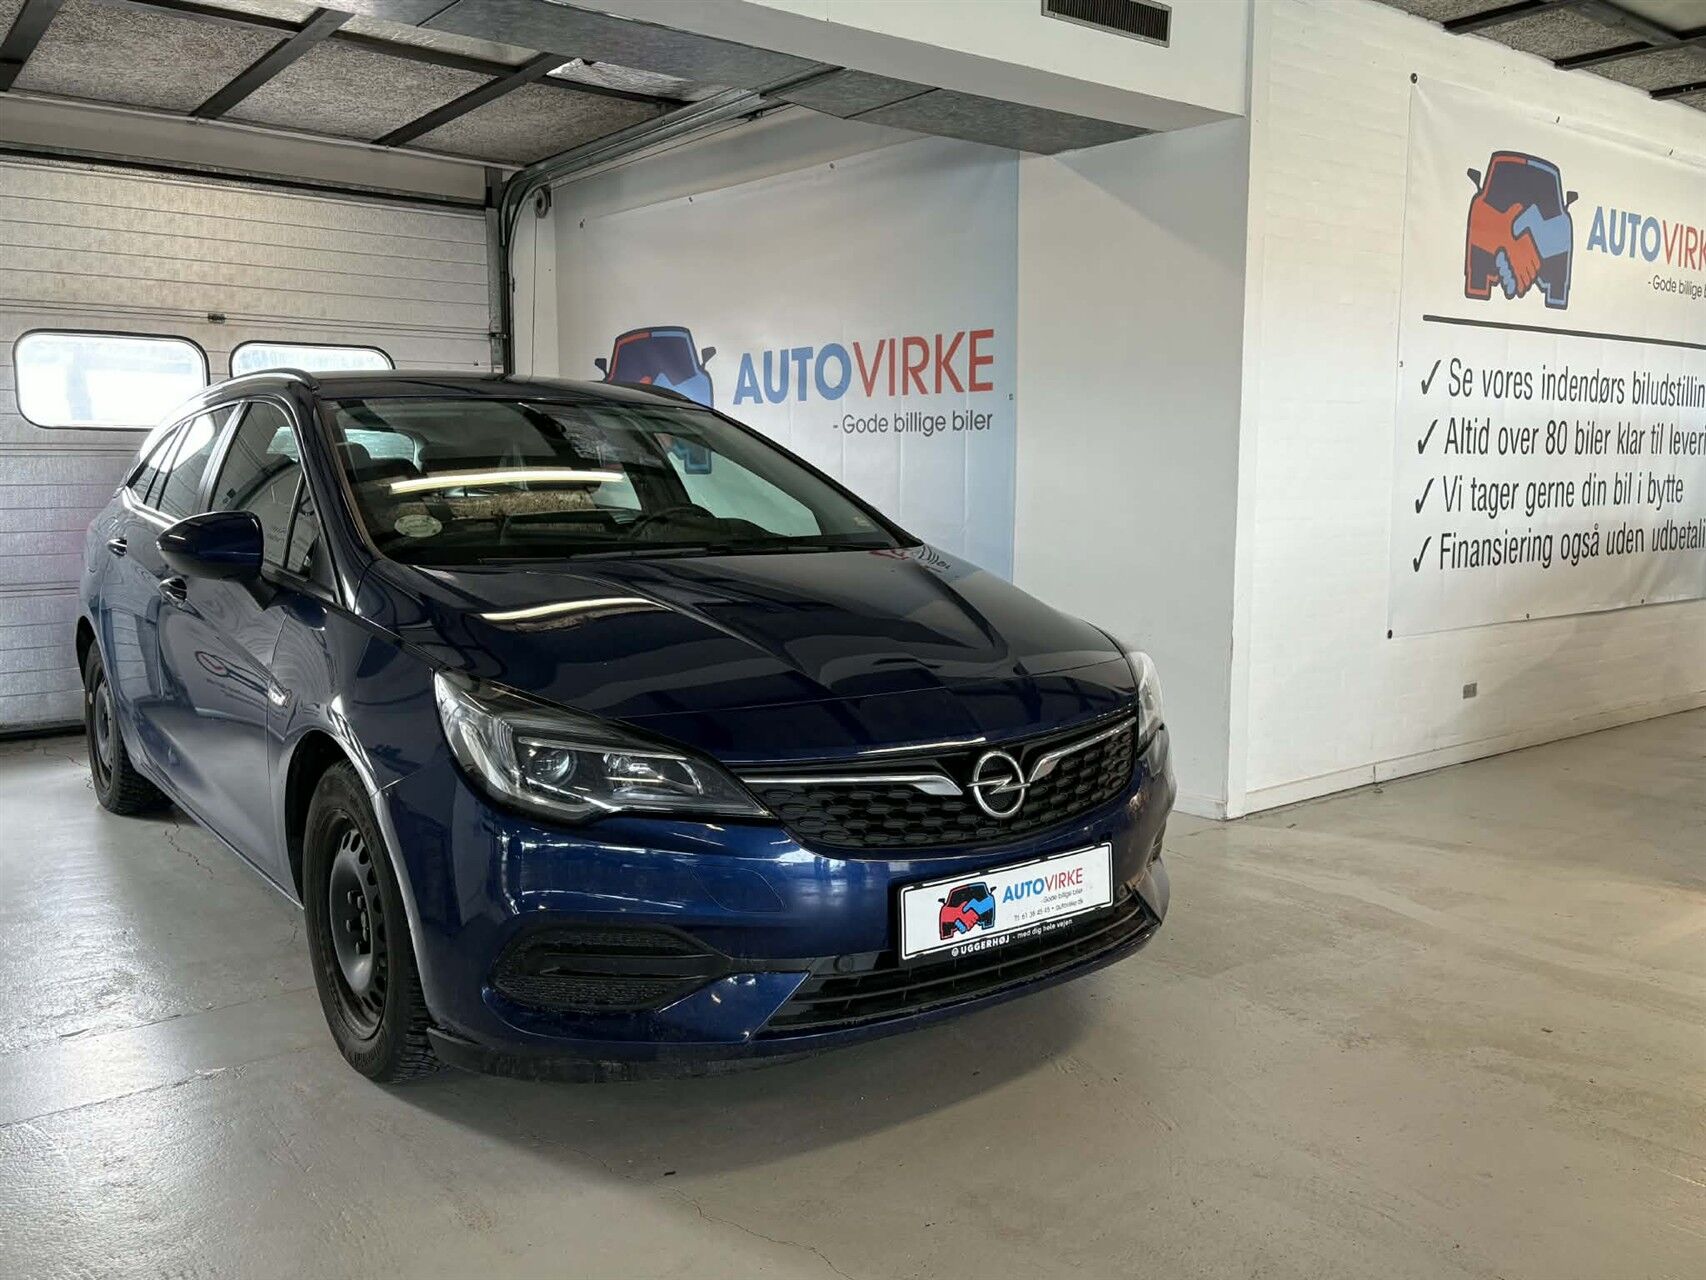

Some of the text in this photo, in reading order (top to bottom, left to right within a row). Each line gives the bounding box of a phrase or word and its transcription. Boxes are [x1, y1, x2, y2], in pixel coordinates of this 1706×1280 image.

[1653, 275, 1677, 293] Gode
[1679, 280, 1702, 300] billige
[733, 328, 994, 405] AUTOVIRKE
[1448, 357, 1706, 409] Se vores indendørs biludstillin
[843, 413, 889, 434] Gode
[894, 411, 946, 438] billige
[952, 410, 993, 433] biler
[1443, 416, 1489, 456] Altid
[1498, 428, 1539, 456] over
[1545, 420, 1568, 456] 80
[1574, 420, 1611, 456] biler
[1617, 421, 1645, 455] klar
[1651, 423, 1664, 455] til
[1442, 472, 1684, 519] Vi tager gerne din bil i bytte
[1440, 519, 1706, 570] Finansiering også uden udbetali
[1003, 868, 1083, 903] AUTOVIRKE
[960, 935, 1010, 954] UGGERHØJ
[1032, 925, 1042, 936] dig
[1056, 918, 1073, 930] vejen
